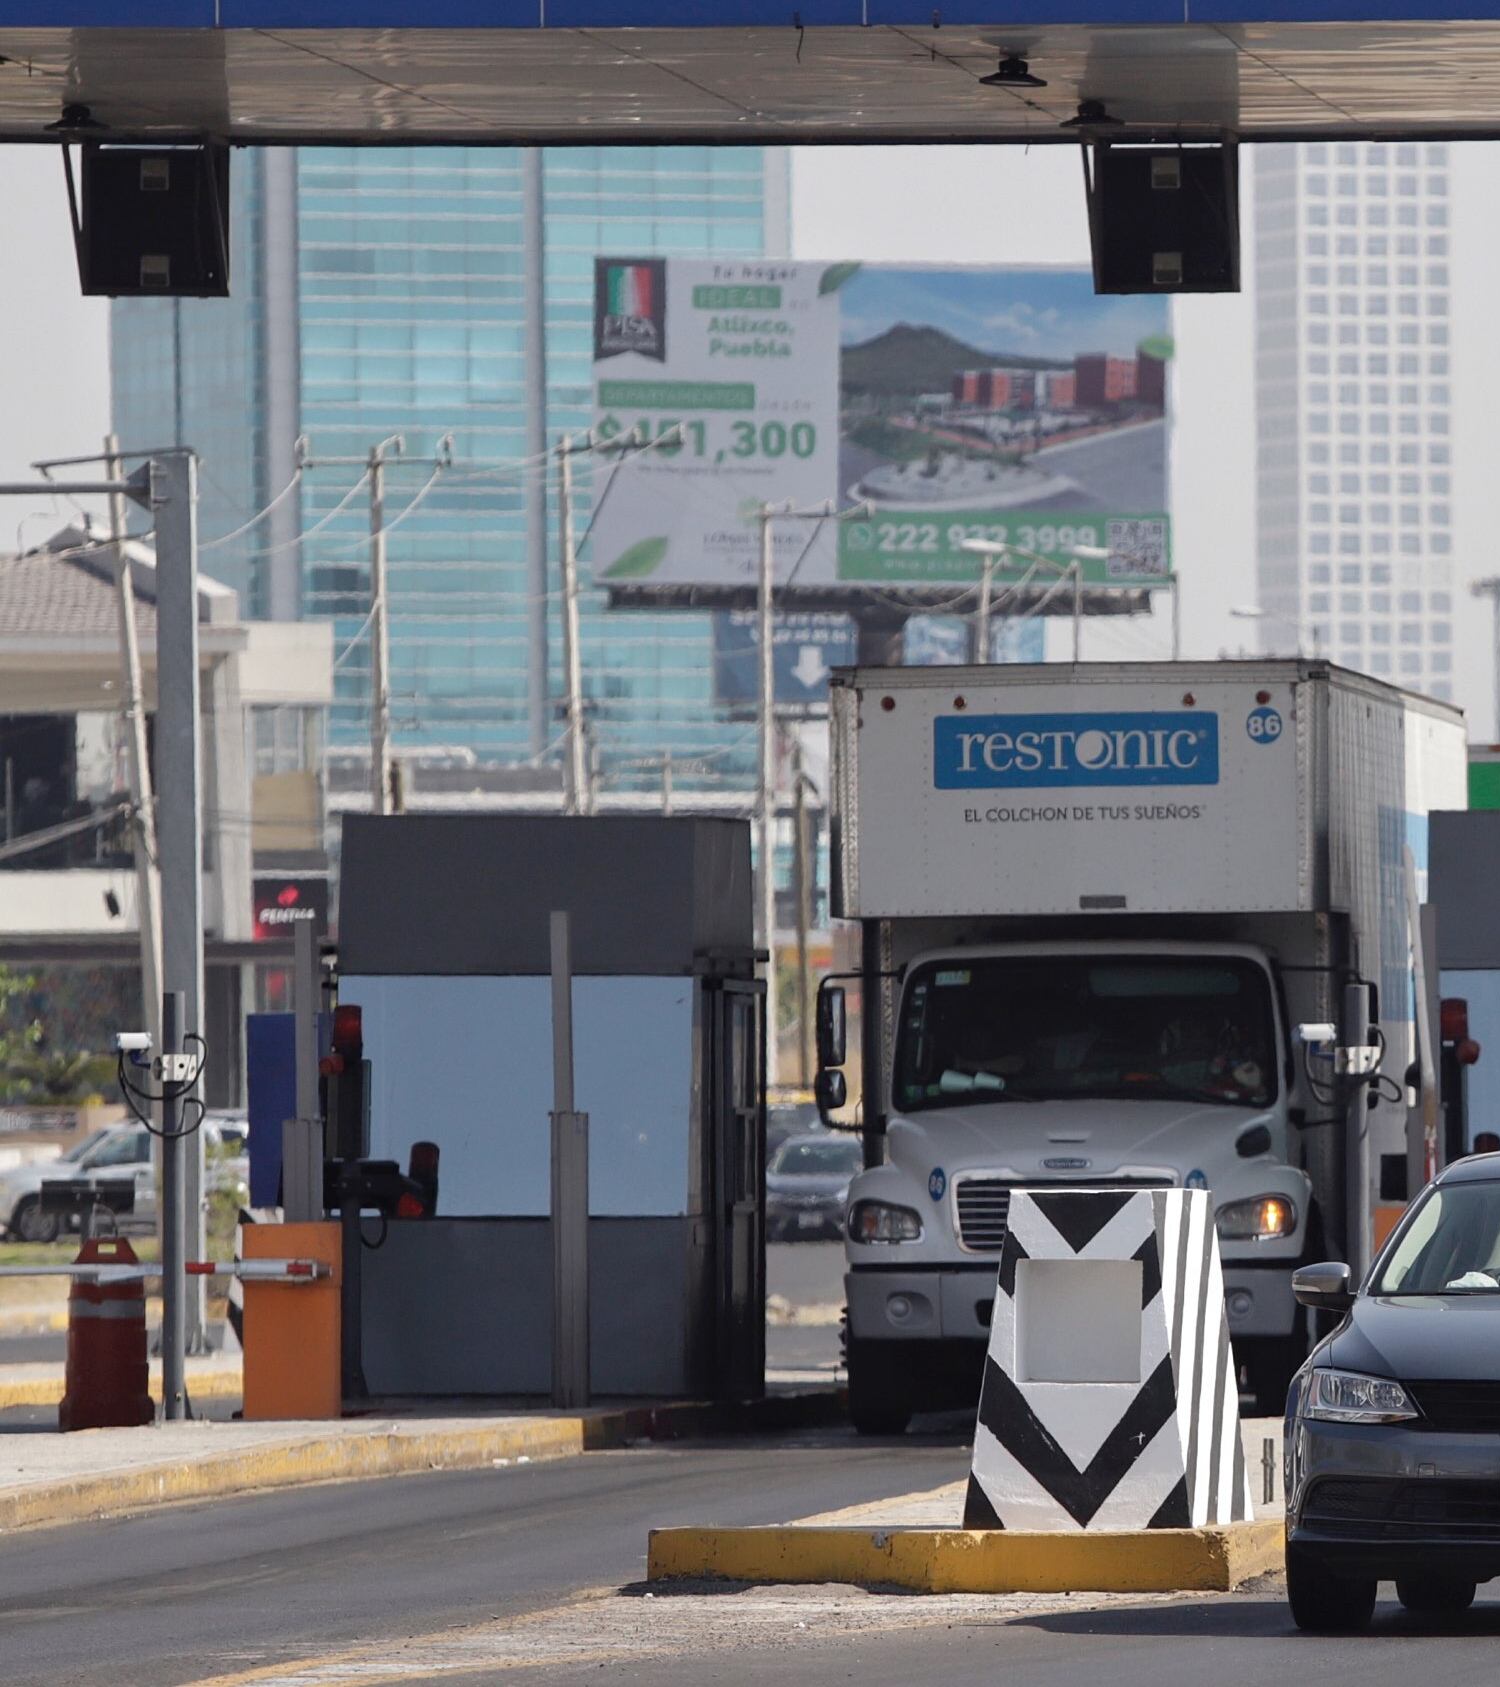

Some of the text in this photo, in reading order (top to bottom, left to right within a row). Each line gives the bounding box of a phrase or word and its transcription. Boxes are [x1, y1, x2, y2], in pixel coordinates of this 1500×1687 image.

[708, 338, 792, 357] Puebla
[877, 523, 939, 552] 222
[1016, 525, 1097, 552] 3999
[1247, 713, 1281, 737] 86
[964, 803, 1200, 823] EL COLCHON DE TUS SUEÑOS
